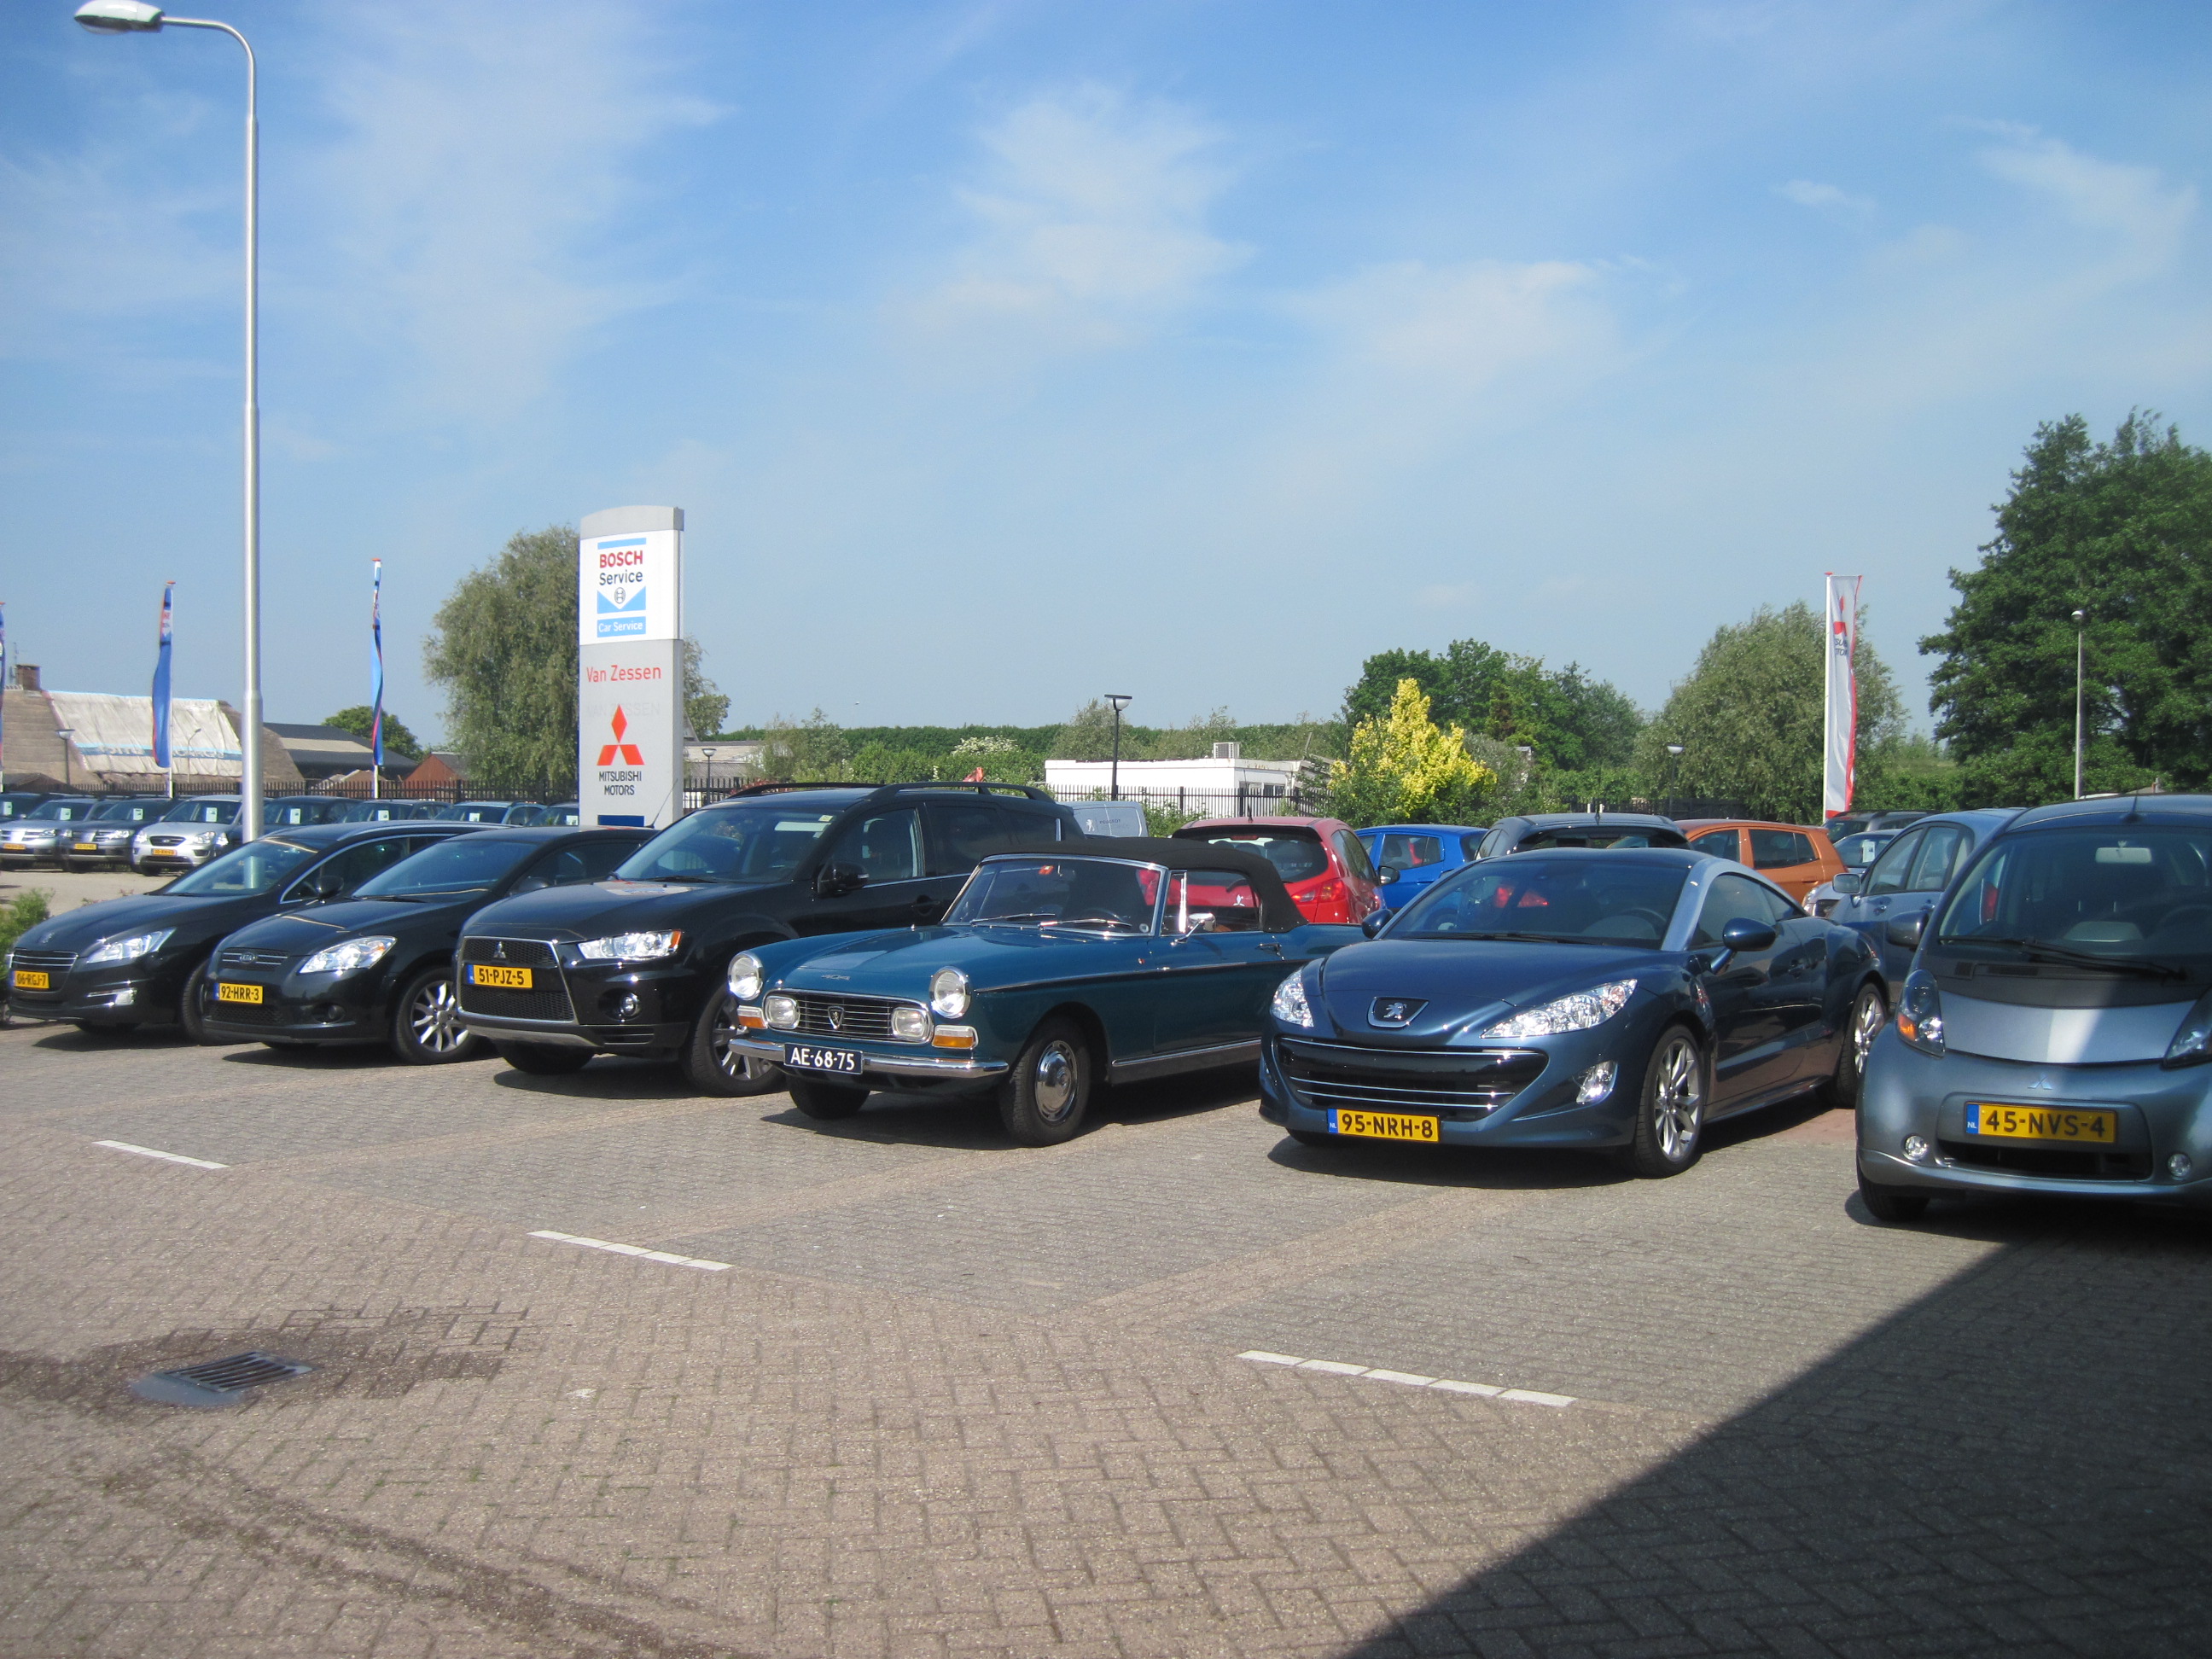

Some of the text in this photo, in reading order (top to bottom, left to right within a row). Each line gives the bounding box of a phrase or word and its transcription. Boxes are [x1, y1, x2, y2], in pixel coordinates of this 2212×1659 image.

[599, 550, 643, 568] BOSCH
[599, 569, 643, 585] Service
[598, 621, 643, 632] Car Service
[586, 665, 661, 683] Van Zessen
[599, 771, 642, 782] MITSUBISHI
[604, 784, 635, 795] MOTORS
[479, 968, 524, 985] 51-PJZ-5
[221, 986, 259, 1001] 92-HRR-3
[790, 1047, 855, 1070] AE-68-75
[1342, 1113, 1433, 1138] 95-NRH-8
[1985, 1109, 2105, 1138] 45-NVS-4
